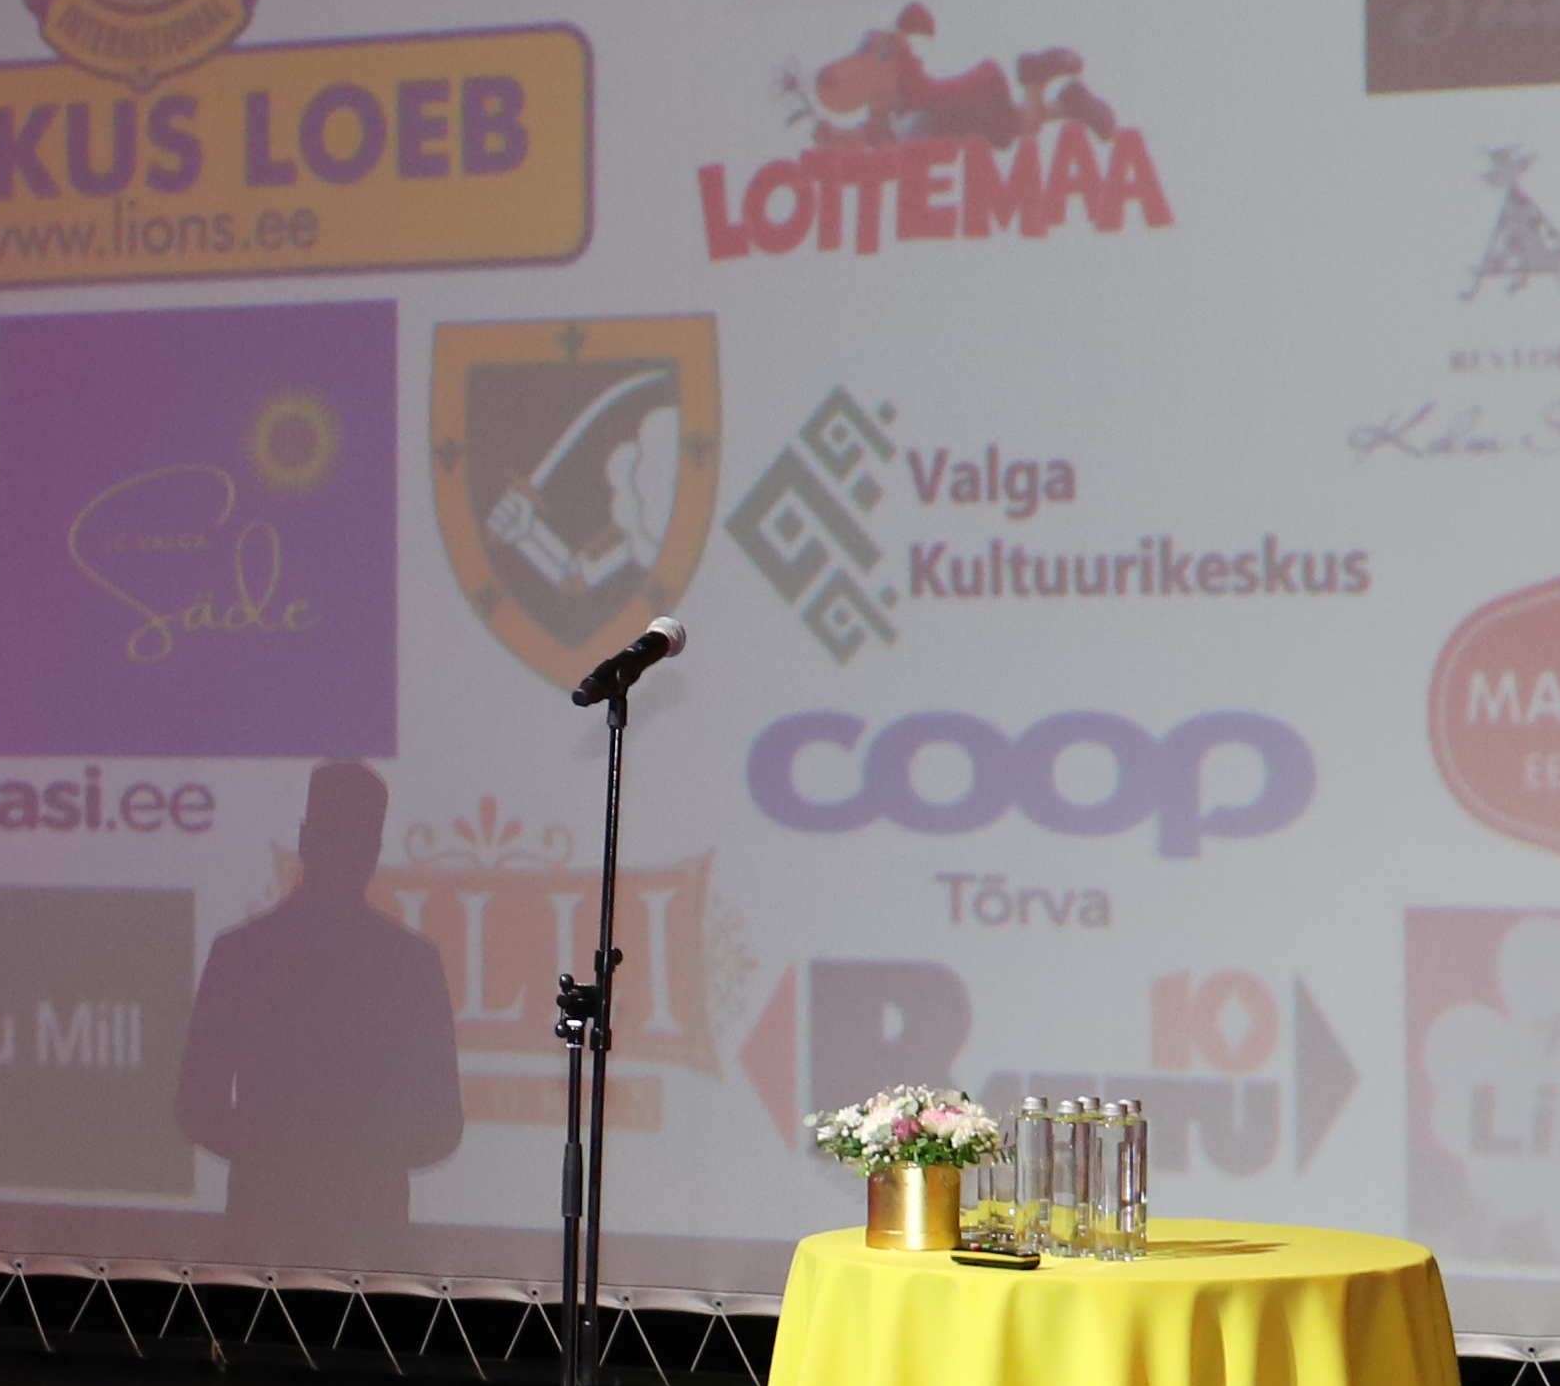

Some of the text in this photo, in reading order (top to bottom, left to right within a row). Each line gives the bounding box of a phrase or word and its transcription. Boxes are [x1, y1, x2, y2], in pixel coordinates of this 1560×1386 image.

[244, 74, 531, 188] LOEB
[697, 120, 1178, 263] LOTTEMAA
[905, 442, 1079, 519] Valga
[907, 532, 1373, 599] Kultuurikeskus
[744, 707, 1318, 861] coop
[932, 870, 1114, 931] Tõrva
[36, 998, 142, 1073] Mill
